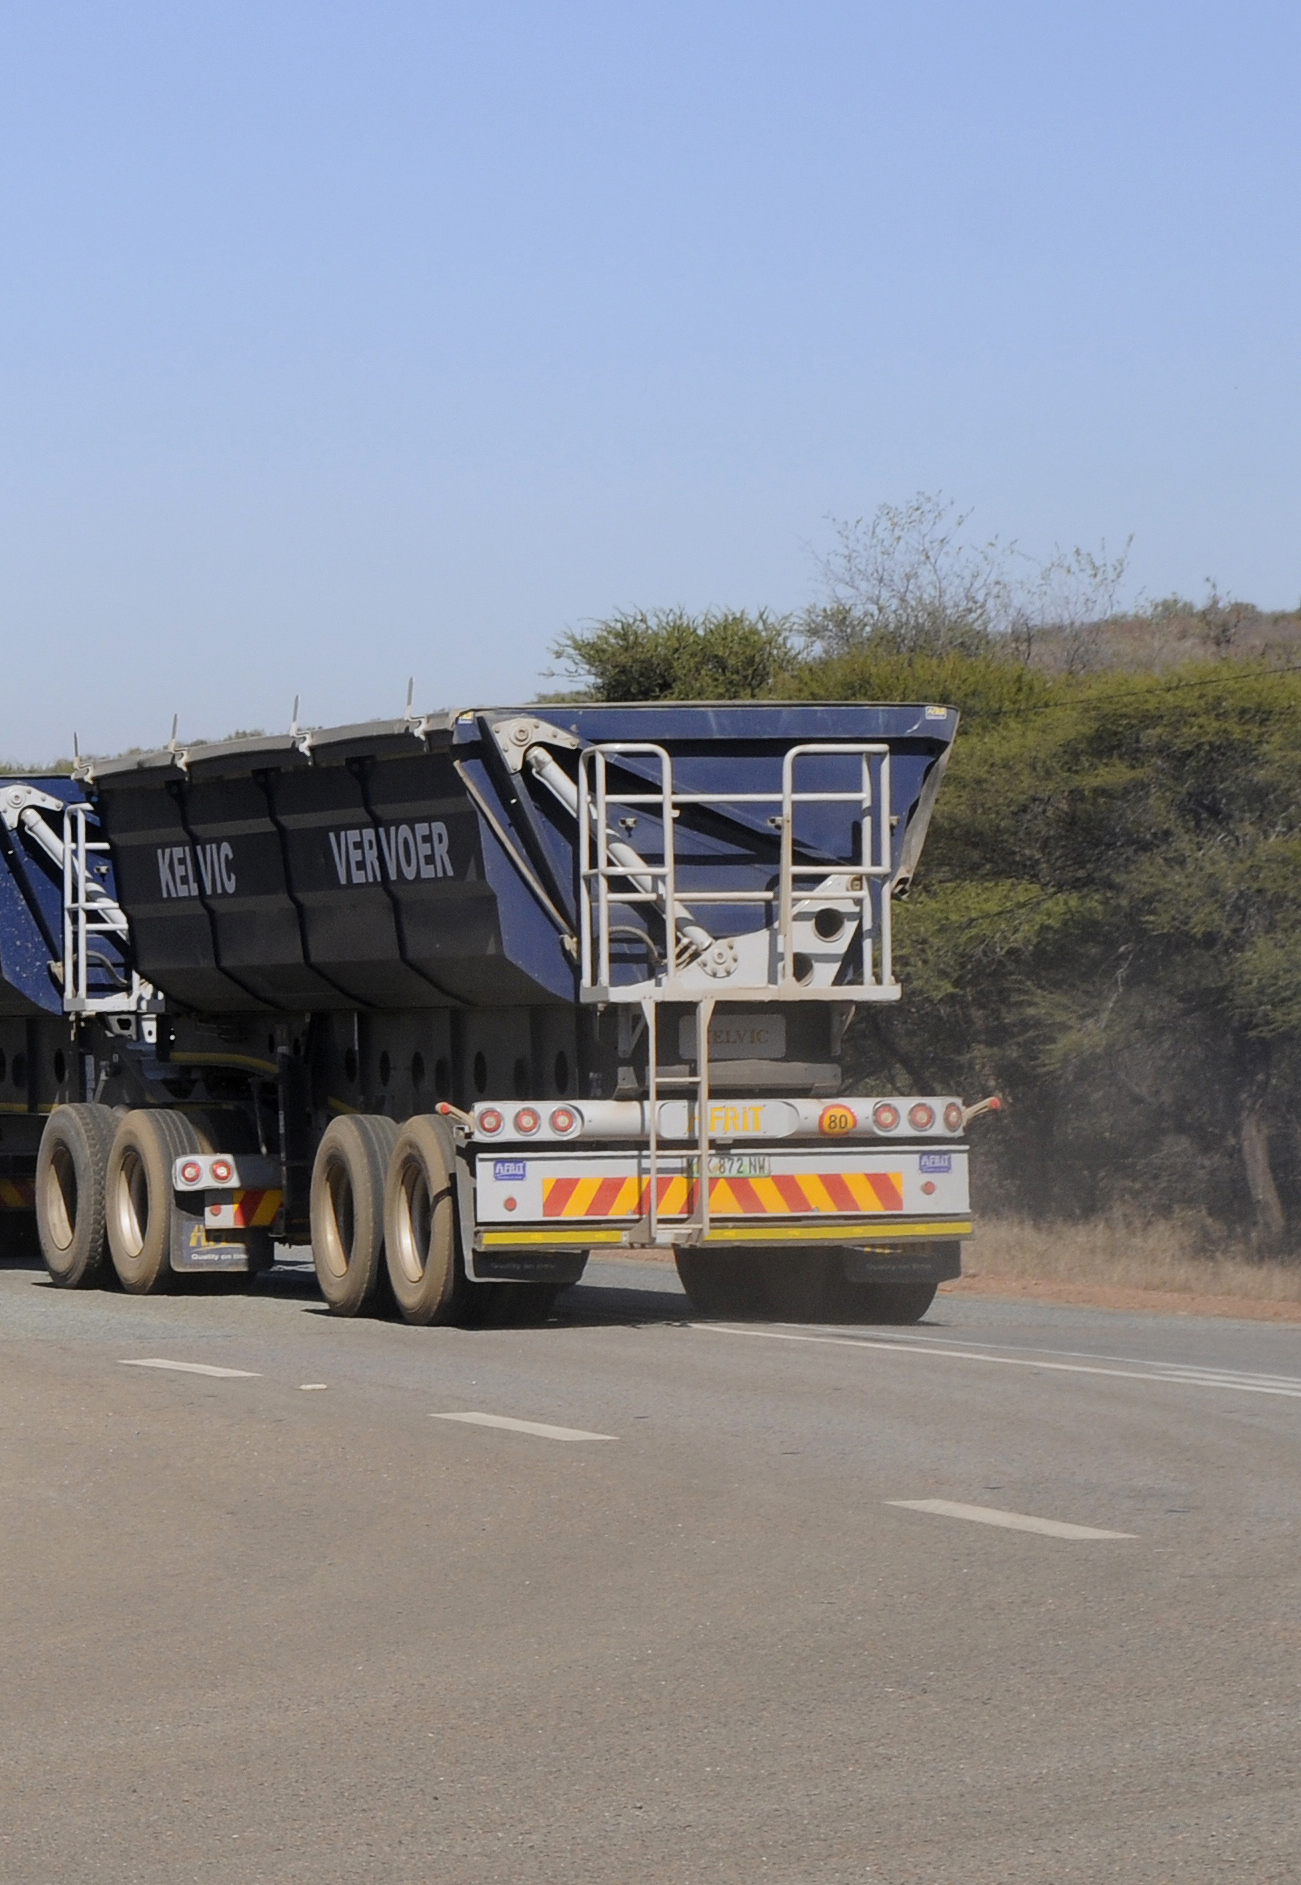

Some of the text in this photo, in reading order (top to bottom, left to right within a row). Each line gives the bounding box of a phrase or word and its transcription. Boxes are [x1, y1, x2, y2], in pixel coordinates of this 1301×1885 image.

[157, 821, 454, 898] KELVIC VERVOER
[707, 1029, 769, 1043] ELVIC
[828, 1114, 848, 1130] 80
[718, 1157, 744, 1174] 872
[748, 1156, 766, 1174] NW
